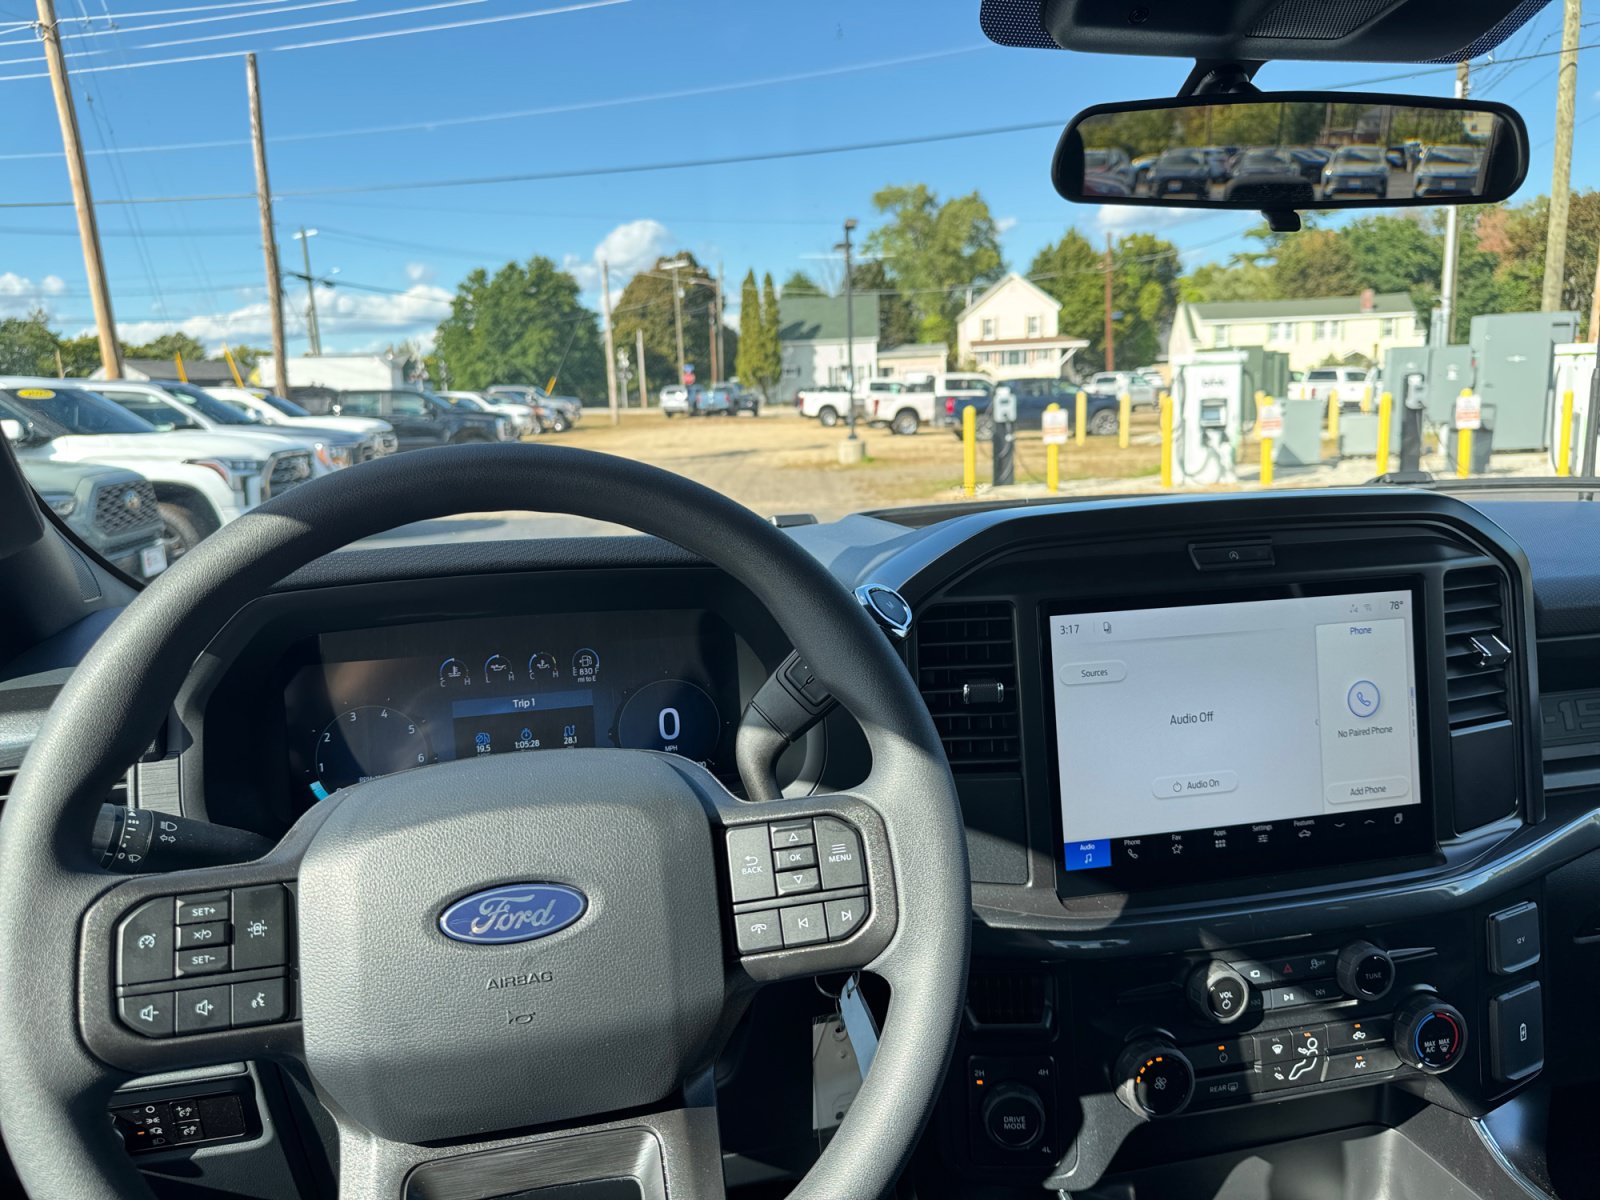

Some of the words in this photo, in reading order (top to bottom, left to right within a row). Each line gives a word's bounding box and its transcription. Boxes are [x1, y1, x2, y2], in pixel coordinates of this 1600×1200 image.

[1059, 624, 1080, 635] 3:17
[1349, 626, 1372, 636] Phone
[529, 672, 535, 680] C
[552, 670, 559, 678] H
[579, 667, 593, 676] 830
[1080, 668, 1109, 678] Sources
[464, 678, 471, 686] H
[508, 673, 515, 682] H
[440, 679, 446, 687] C
[512, 699, 531, 709] Trip
[531, 698, 536, 707] 1
[350, 712, 357, 721] 3
[381, 709, 388, 718] 4
[1169, 713, 1198, 725] Audio
[1199, 711, 1214, 723] Off
[658, 707, 680, 740] 0
[408, 724, 415, 734] 5
[1337, 729, 1348, 738] No
[1348, 728, 1371, 738] Paired
[1371, 726, 1393, 735] Phone
[324, 732, 331, 742] 2
[563, 736, 578, 745] 28.1
[476, 744, 491, 752] 19.5
[514, 740, 540, 749] 1:05:28
[665, 744, 678, 752] MPH
[418, 753, 425, 763] 6
[319, 763, 324, 772] 1
[1186, 779, 1208, 790] Audio
[1208, 779, 1220, 788] On
[1350, 787, 1364, 796] Add
[1364, 785, 1387, 795] Phone
[1213, 829, 1227, 837] Apps
[1252, 824, 1273, 833] Settings
[1123, 838, 1141, 846] Phone
[1079, 843, 1095, 851] Audio
[789, 853, 802, 861] OK
[828, 853, 852, 862] MENU
[741, 865, 763, 875] BACK
[191, 907, 216, 917] SET+
[469, 894, 557, 936] Ford
[1365, 971, 1383, 980] TUNE
[486, 970, 553, 991] AIRBAG
[1219, 990, 1234, 999] VOL
[1354, 1060, 1367, 1069] A/C
[974, 1069, 985, 1077] 2H
[1038, 1068, 1049, 1076] 4H
[1209, 1084, 1227, 1093] REAR
[1003, 1115, 1026, 1123] DRIVE
[1003, 1122, 1027, 1130] MODE
[1041, 1146, 1052, 1154] 4L
